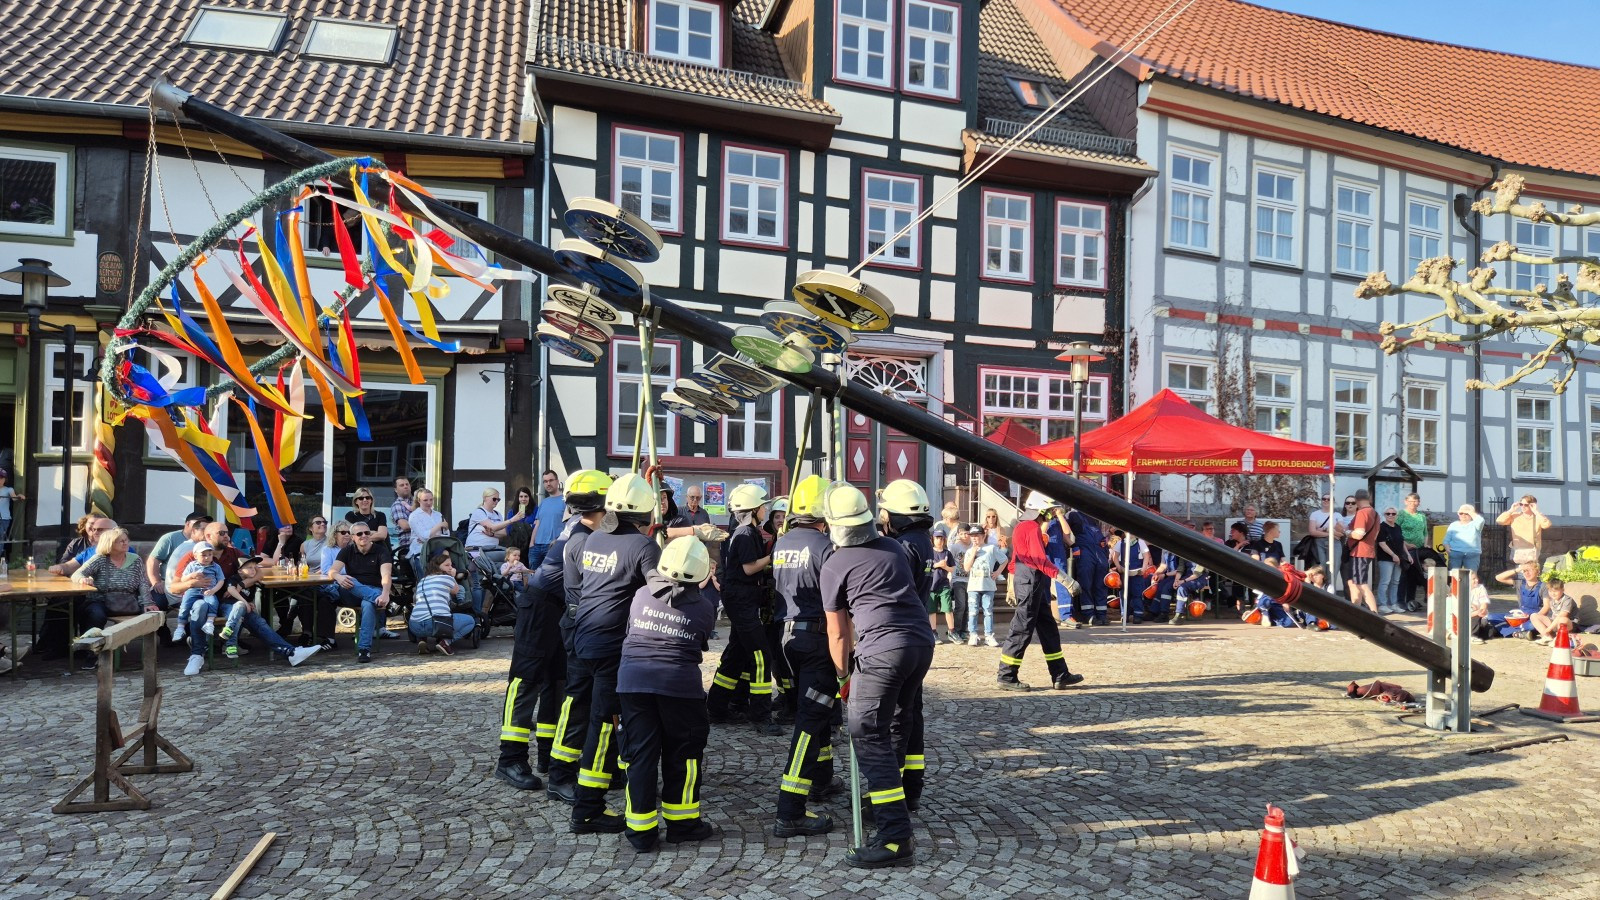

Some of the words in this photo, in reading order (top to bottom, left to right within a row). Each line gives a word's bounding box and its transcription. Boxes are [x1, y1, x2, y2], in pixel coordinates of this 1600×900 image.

[1257, 459, 1327, 468] STADTOLDENDORF
[642, 606, 691, 626] Feuerwehr
[633, 618, 697, 640] Stadtoldendorf
